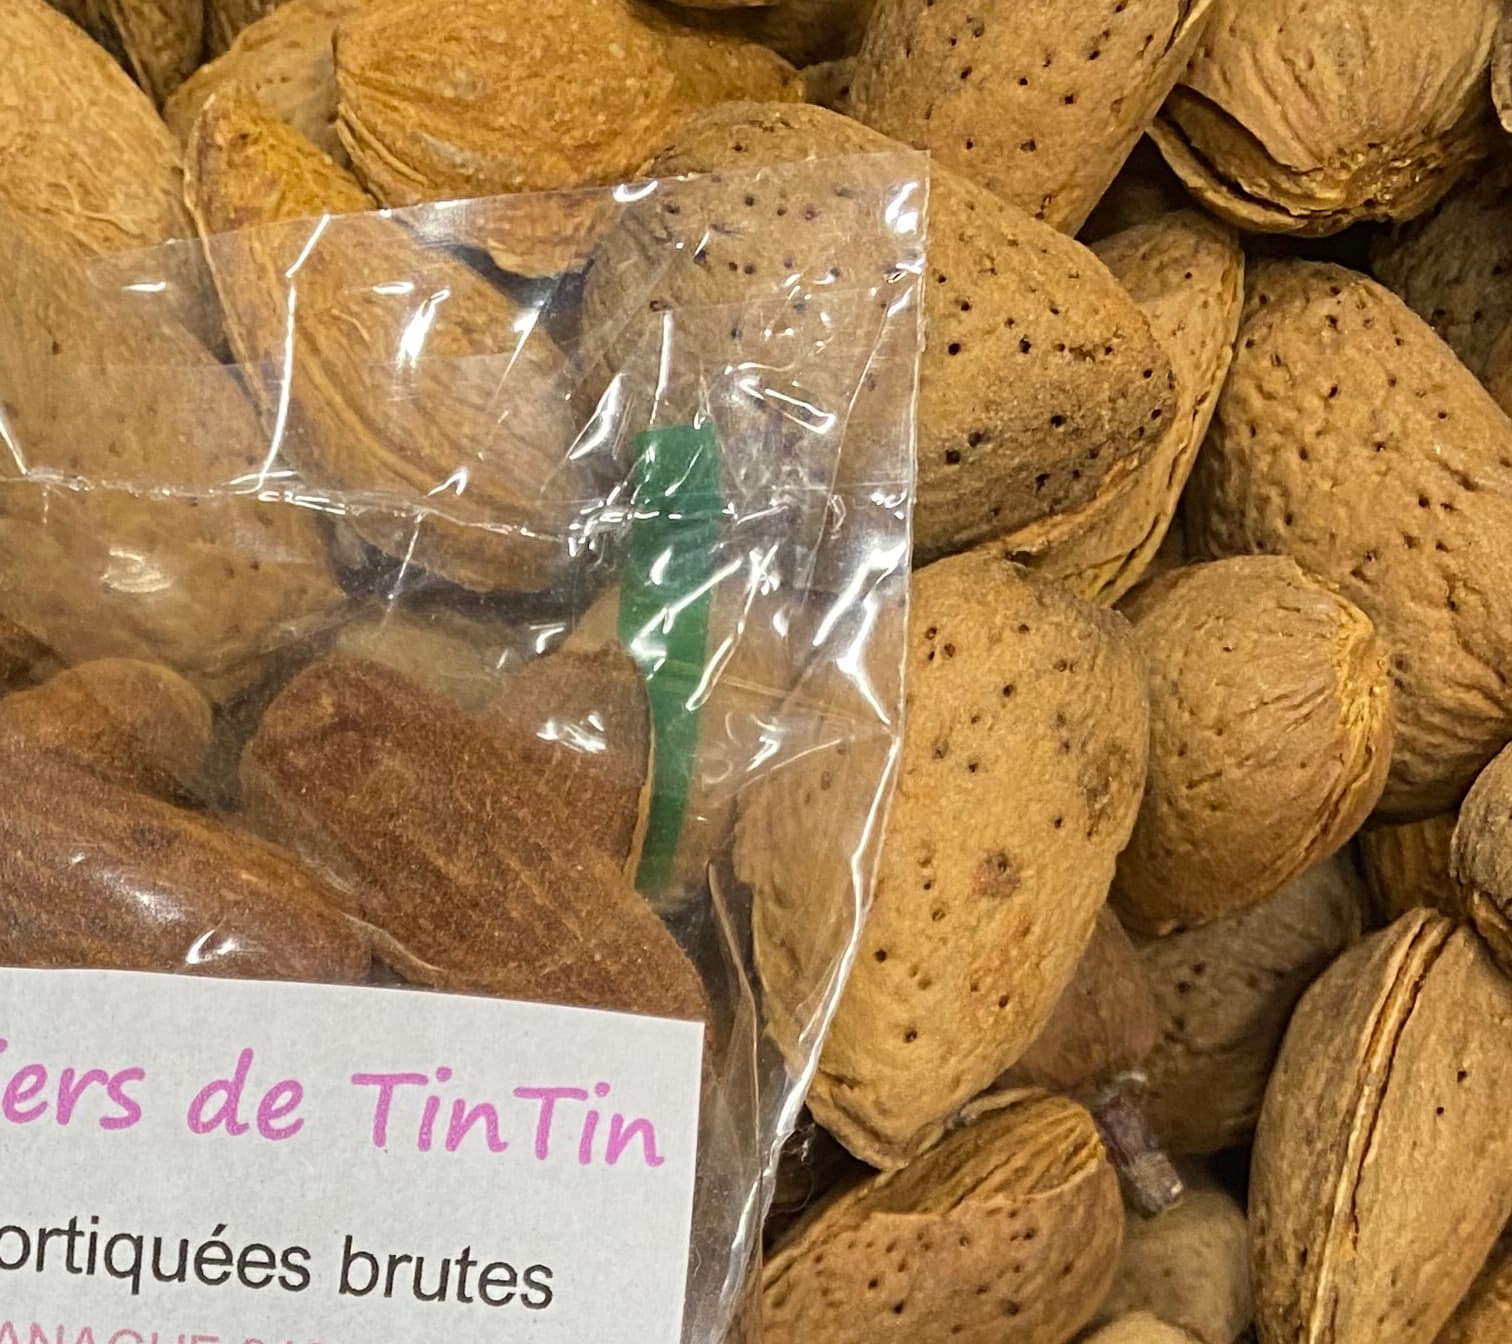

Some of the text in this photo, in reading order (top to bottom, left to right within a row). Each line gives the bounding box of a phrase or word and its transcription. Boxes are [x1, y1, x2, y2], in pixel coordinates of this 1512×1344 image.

[188, 1048, 304, 1140] de
[352, 1067, 664, 1166] TinTin
[339, 1234, 553, 1310] brutes
